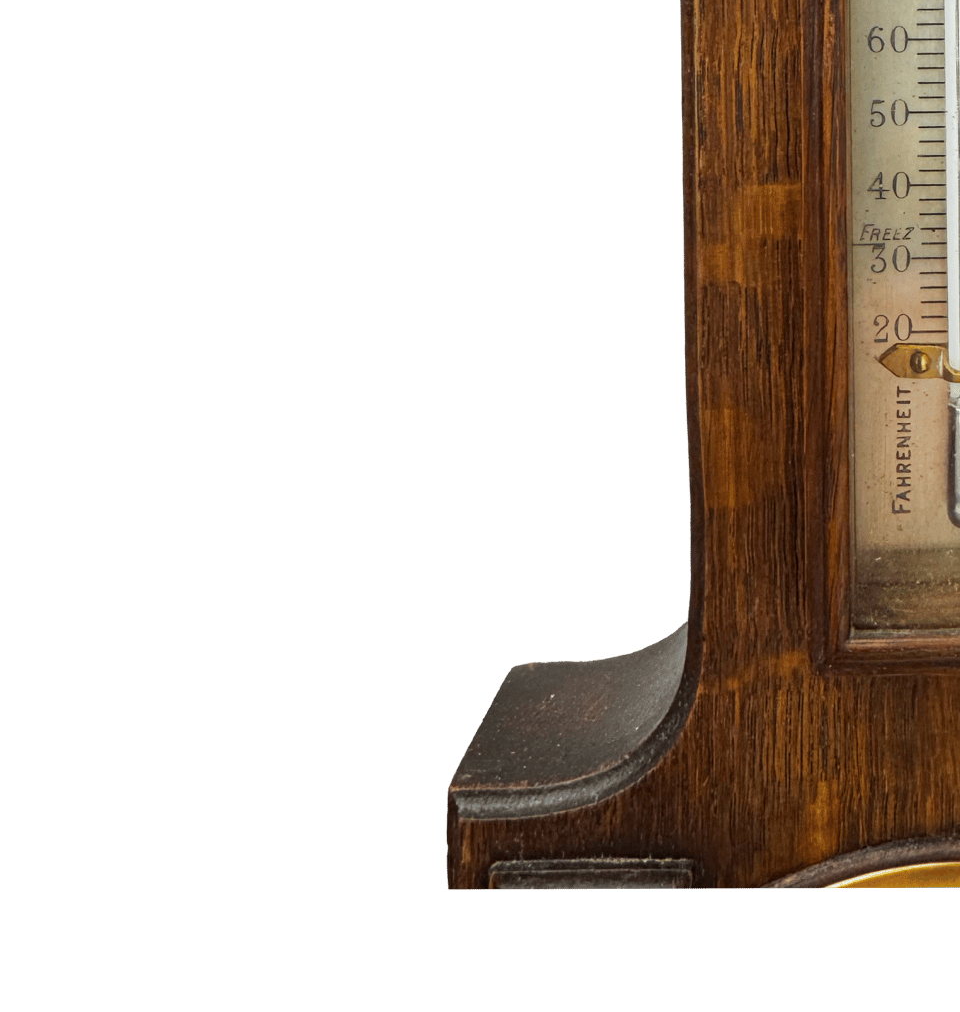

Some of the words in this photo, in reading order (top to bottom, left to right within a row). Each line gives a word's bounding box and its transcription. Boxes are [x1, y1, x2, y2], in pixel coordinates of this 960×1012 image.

[867, 25, 909, 54] 60
[869, 98, 910, 128] 50
[867, 171, 911, 200] 40
[859, 223, 915, 241] FREEZ
[870, 244, 911, 274] 30
[873, 313, 913, 343] 20
[891, 386, 912, 515] FAHRENHEIT
